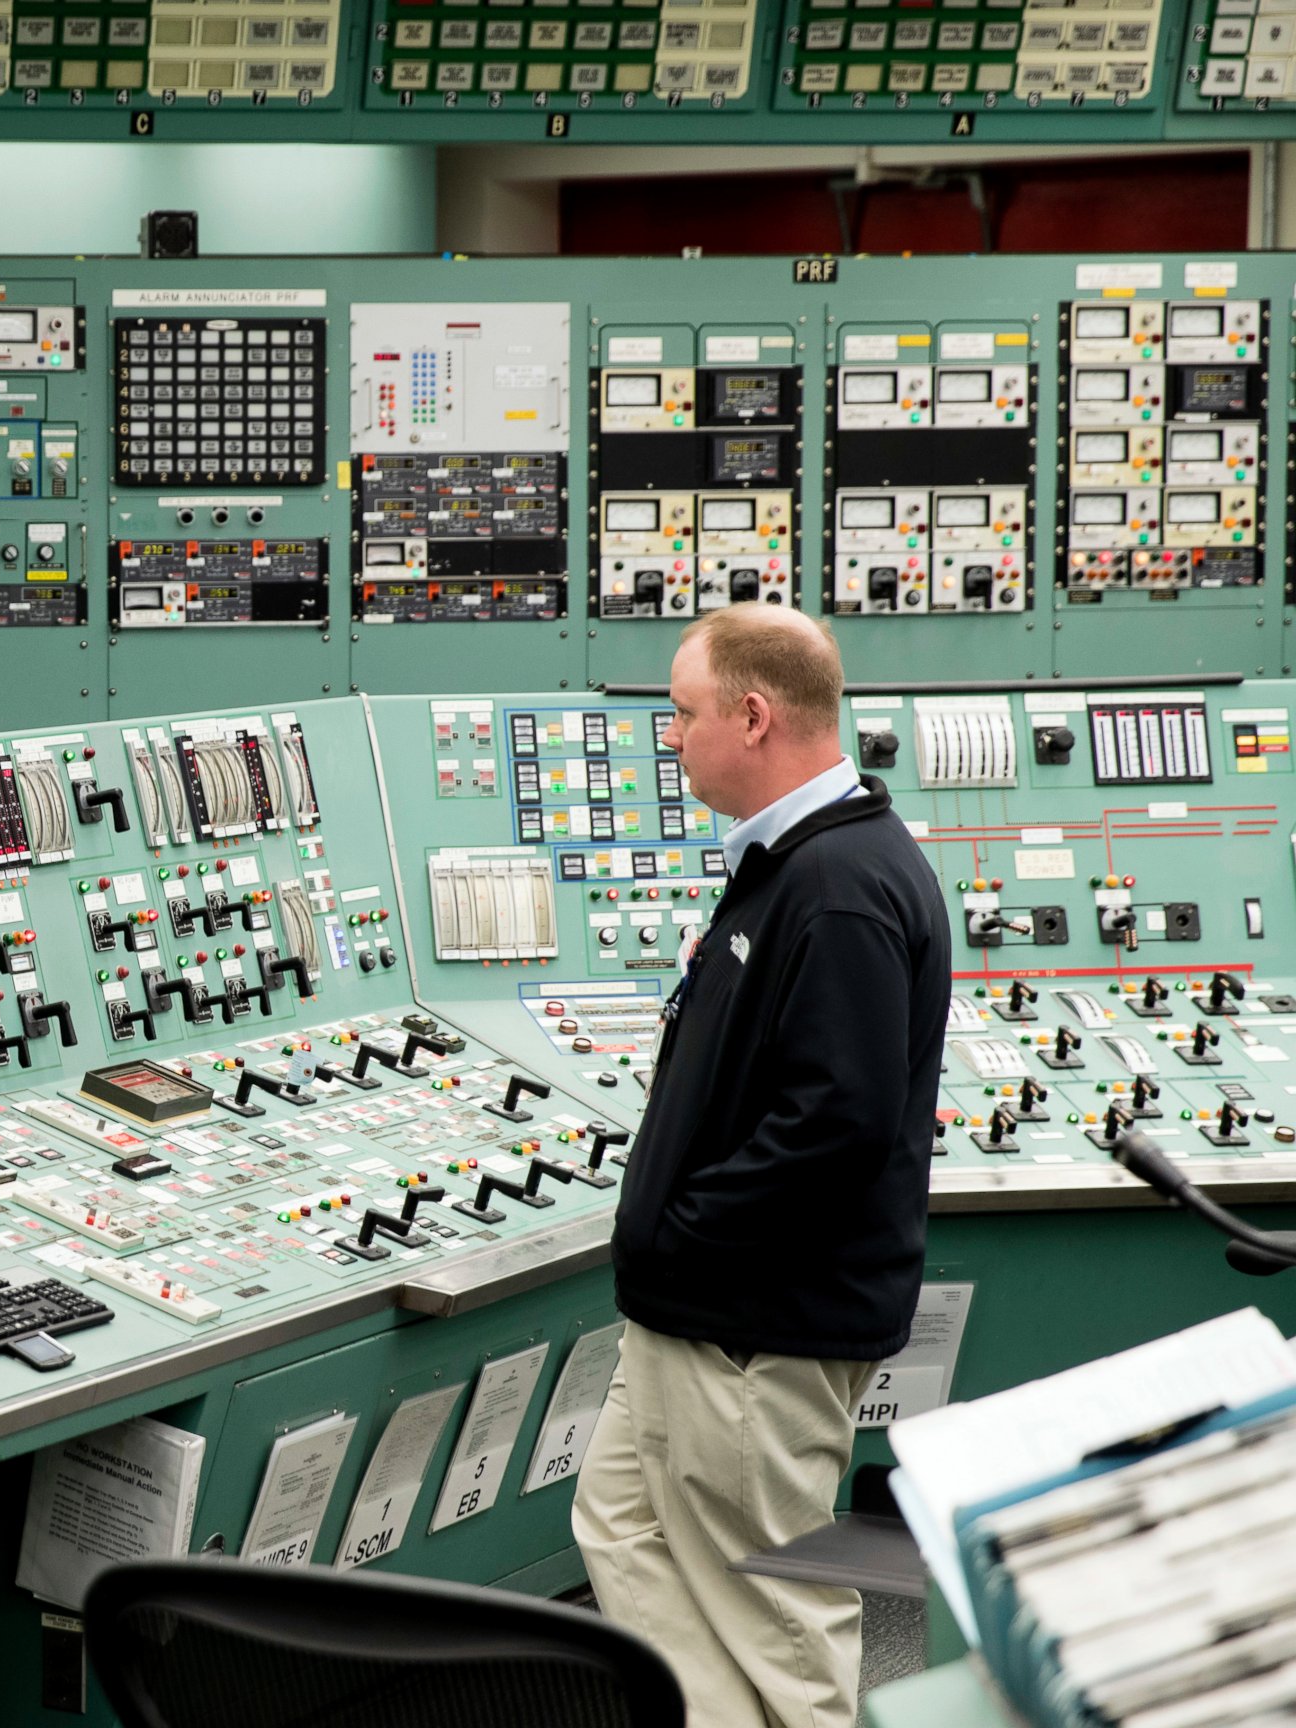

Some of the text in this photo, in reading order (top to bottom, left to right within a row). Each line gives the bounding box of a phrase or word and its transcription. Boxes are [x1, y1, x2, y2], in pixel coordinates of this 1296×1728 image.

[26, 90, 36, 104] 2
[72, 90, 81, 104] 3
[118, 90, 128, 104] 4
[164, 90, 174, 104] 5
[210, 90, 220, 104] 6
[255, 90, 264, 104] 7
[300, 90, 310, 105] 8
[136, 114, 148, 134] C
[552, 116, 564, 135] B
[956, 115, 970, 134] A
[796, 261, 834, 282] PRF
[139, 293, 300, 302] ALARM ANNUNCIATOR PRF
[122, 332, 127, 342] 1
[120, 350, 128, 362] 2
[120, 368, 128, 380] 3
[120, 386, 128, 398] 4
[120, 405, 128, 416] 5
[120, 424, 128, 434] 6
[121, 442, 128, 453] 7
[120, 460, 128, 471] 8
[138, 472, 307, 482] 1 2 3 4 5 6 7 8
[876, 1373, 892, 1390] 2
[858, 1402, 898, 1422] HPI
[564, 1424, 576, 1446] 6
[91, 1446, 154, 1480] WORKSTATION
[474, 1456, 488, 1480] 5
[543, 1452, 573, 1480] PTS
[64, 1450, 163, 1497] Immediate Manual Action
[382, 1498, 392, 1522] 1
[456, 1488, 481, 1518] EB
[297, 1539, 308, 1560] 9
